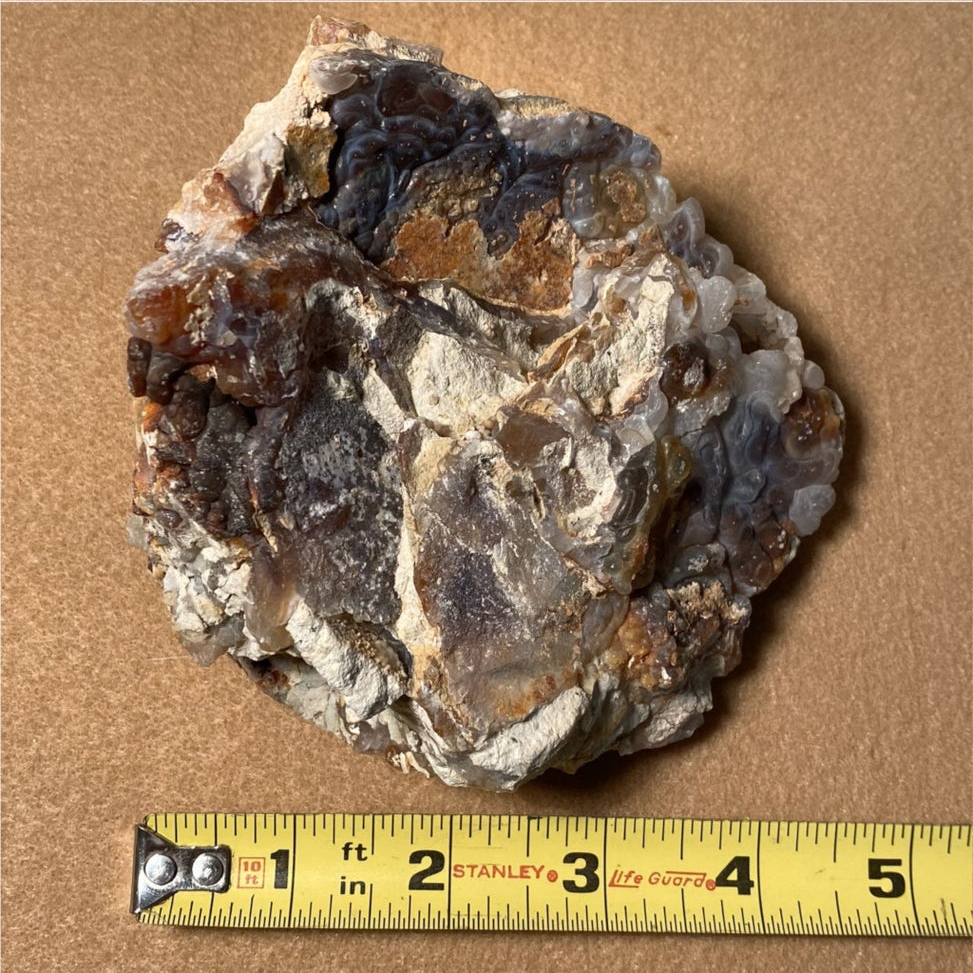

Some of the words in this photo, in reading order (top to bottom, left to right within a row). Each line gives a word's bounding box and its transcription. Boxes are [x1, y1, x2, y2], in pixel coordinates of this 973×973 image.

[242, 861, 260, 872] 10
[270, 850, 289, 889] 1
[342, 843, 368, 861] ft
[408, 850, 444, 890] 2
[246, 875, 259, 885] ft
[340, 877, 365, 895] in
[562, 852, 599, 893] 3
[715, 856, 754, 895] 4
[868, 858, 906, 898] 5
